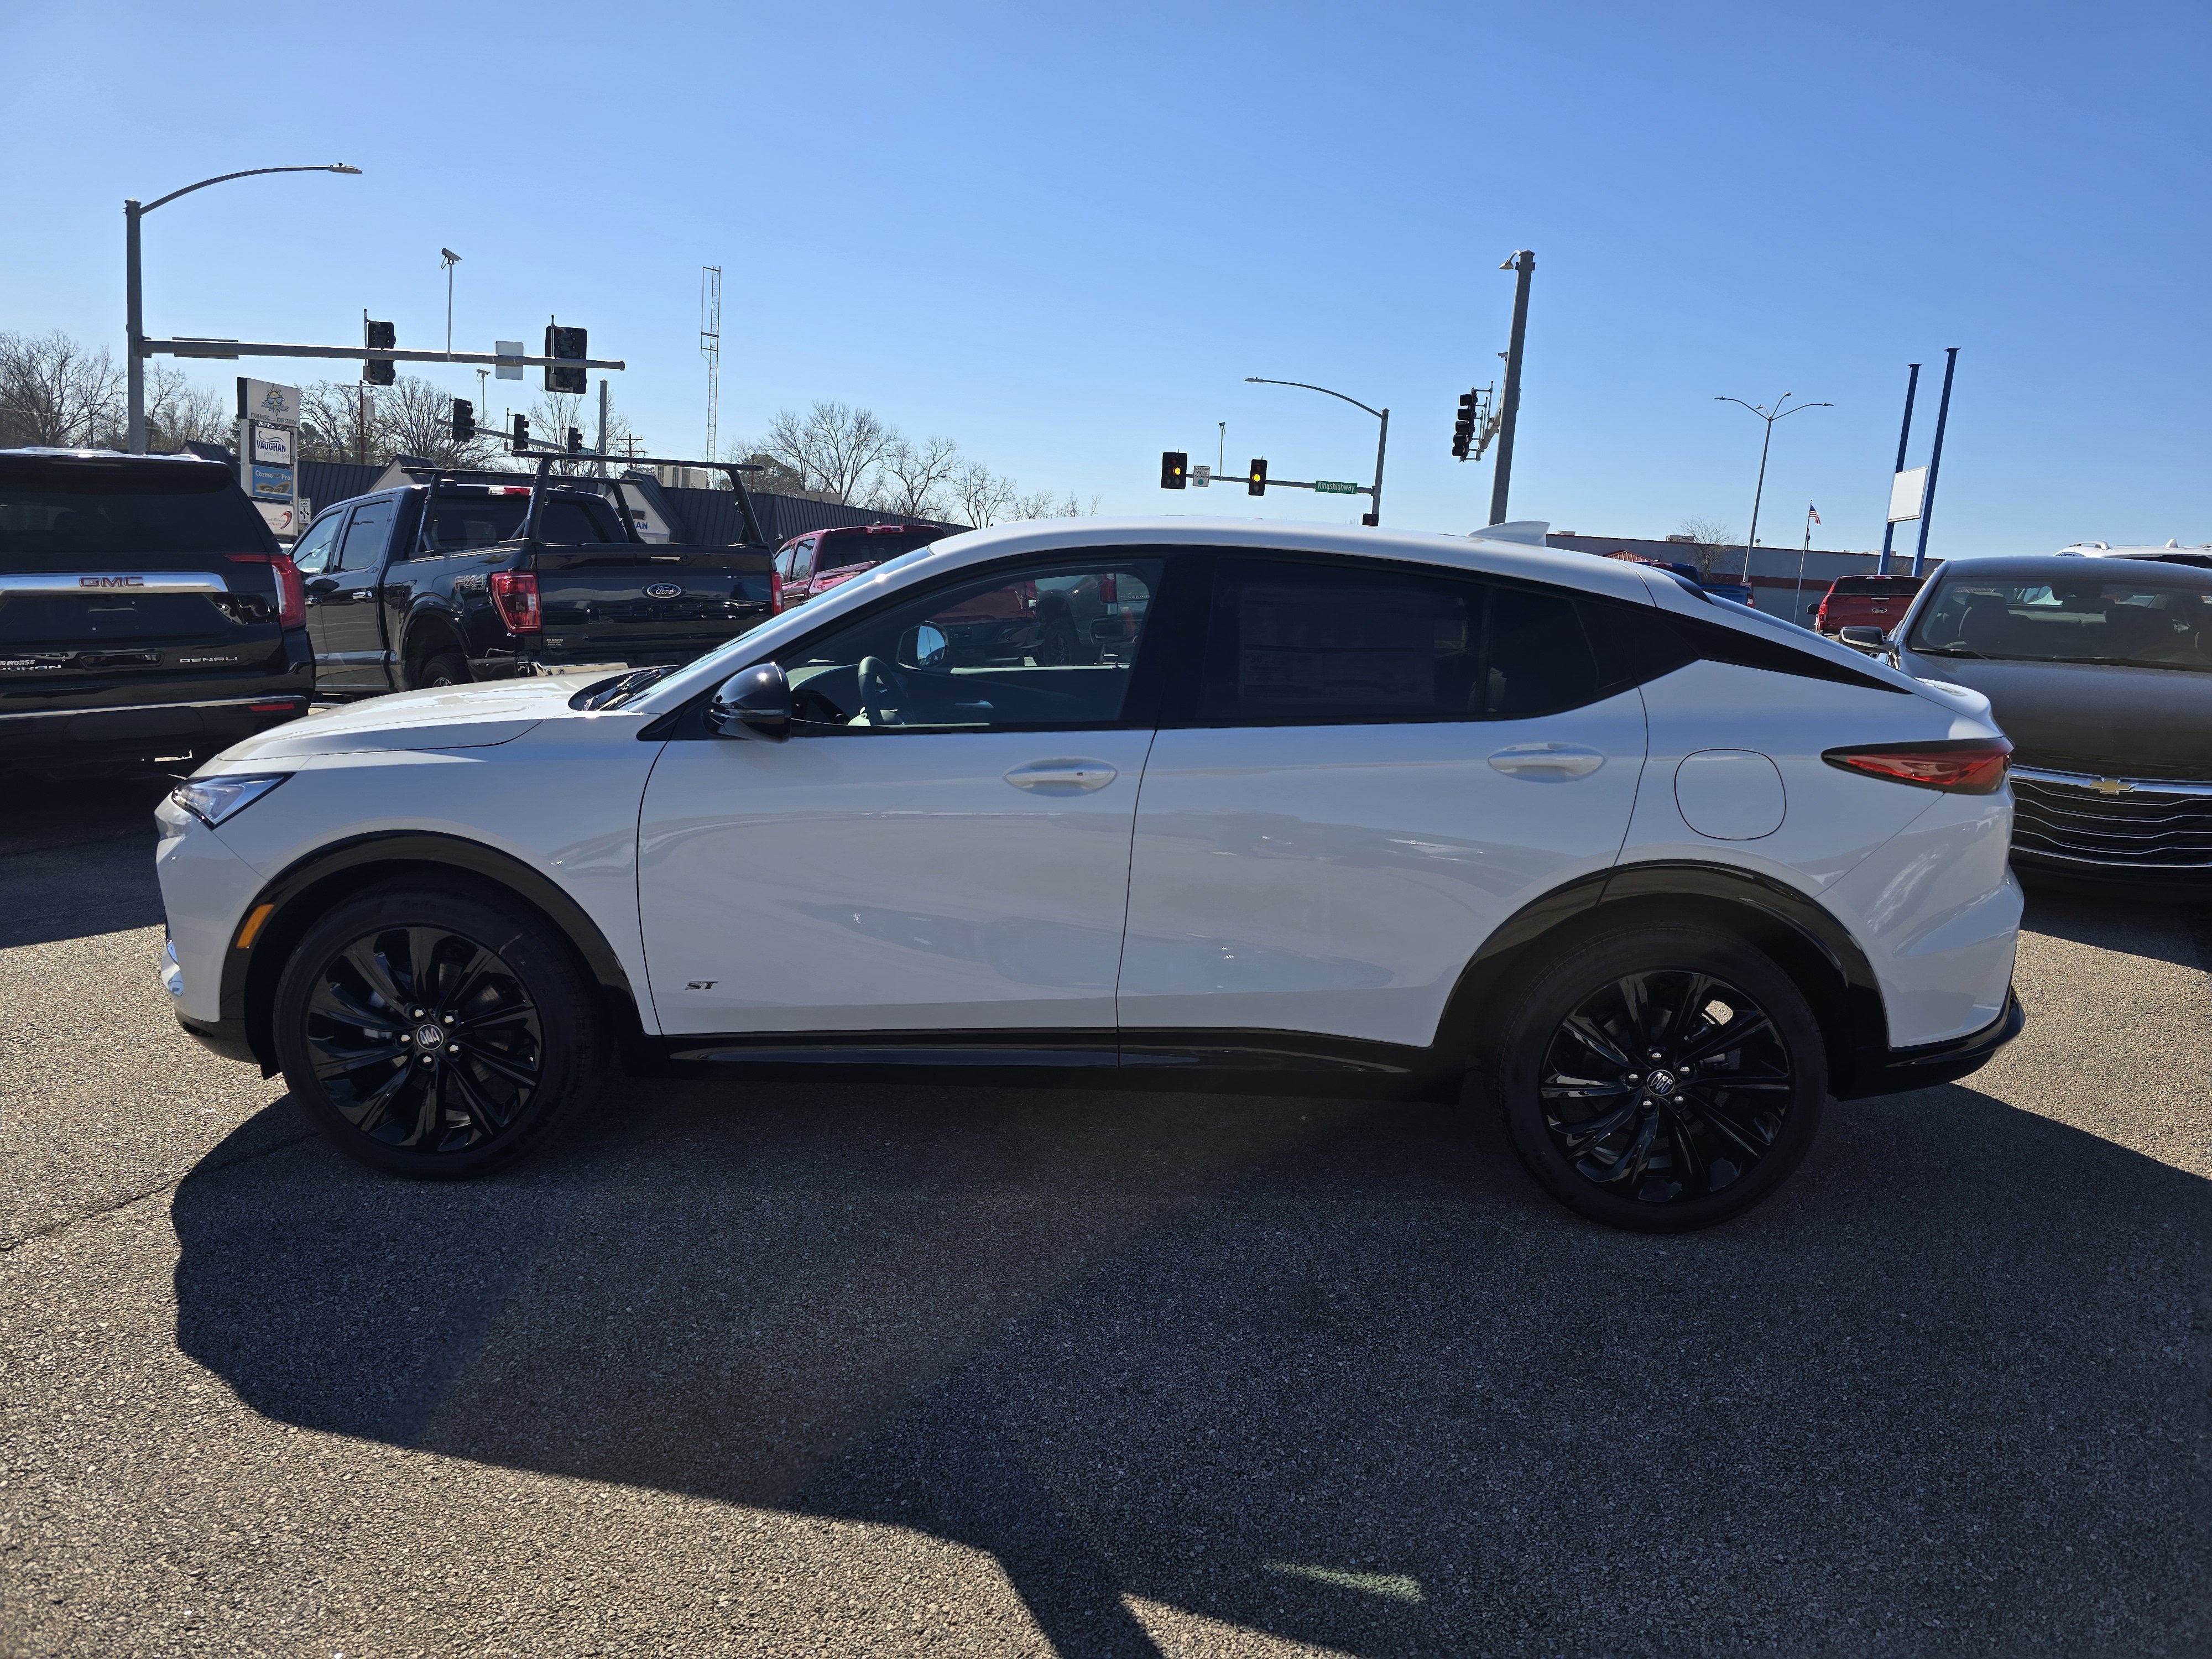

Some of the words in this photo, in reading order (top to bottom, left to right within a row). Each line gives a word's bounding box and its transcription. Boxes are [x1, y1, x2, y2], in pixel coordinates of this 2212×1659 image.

[256, 440, 286, 452] VAUGHAN
[255, 470, 273, 479] Cosmo
[1318, 481, 1355, 493] Kingshighway
[636, 521, 648, 530] AN
[79, 576, 144, 588] GMC
[455, 573, 486, 592] FX4
[685, 980, 719, 990] ST
